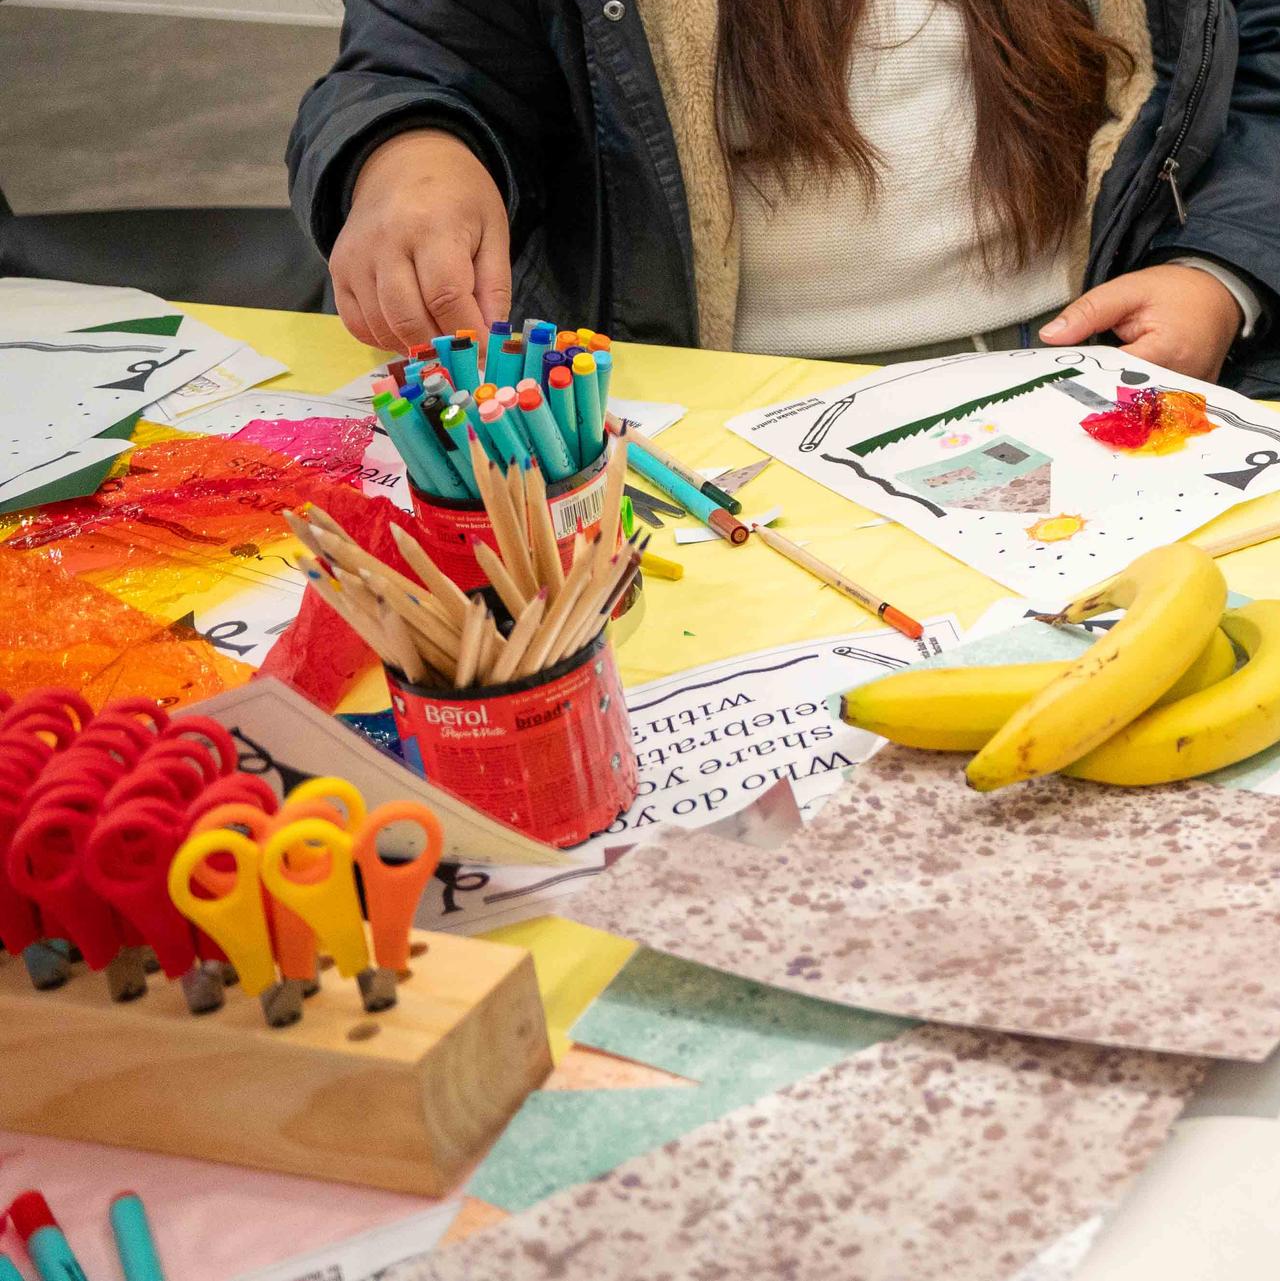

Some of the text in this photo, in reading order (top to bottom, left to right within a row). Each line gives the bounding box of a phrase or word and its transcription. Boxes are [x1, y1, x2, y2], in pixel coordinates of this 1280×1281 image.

[423, 704, 489, 728] Berol
[636, 700, 829, 773] elebrati
[604, 751, 859, 835] Who do yo
[635, 724, 834, 797] share yo
